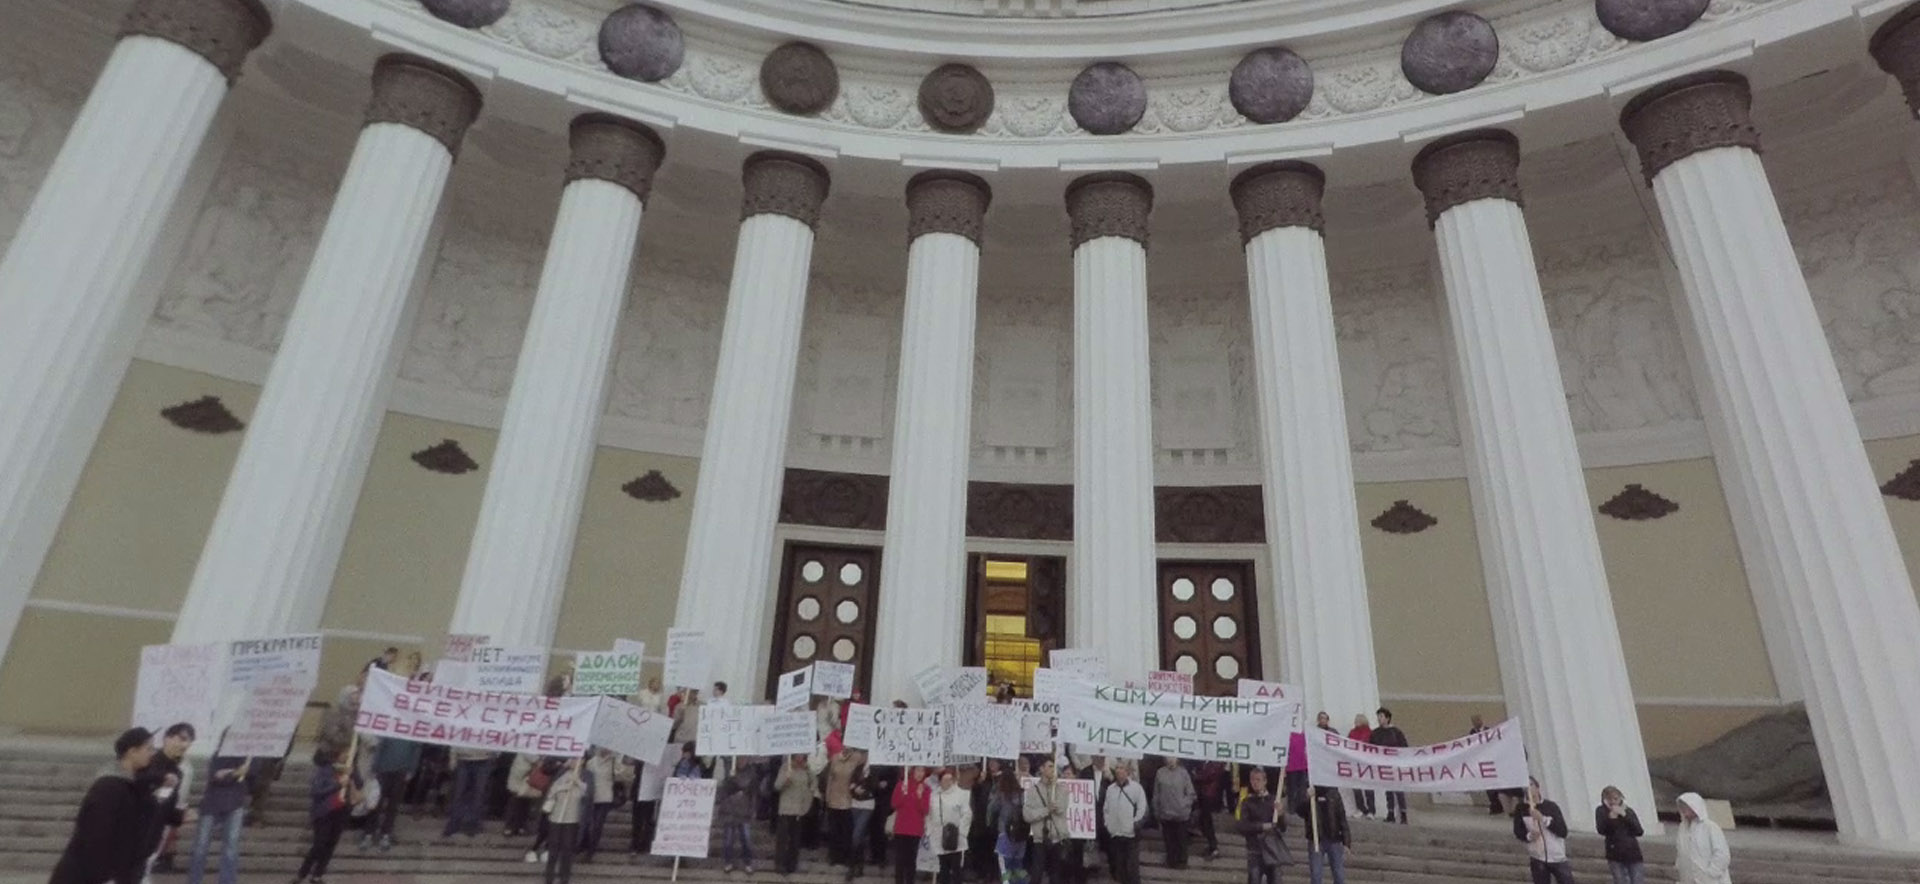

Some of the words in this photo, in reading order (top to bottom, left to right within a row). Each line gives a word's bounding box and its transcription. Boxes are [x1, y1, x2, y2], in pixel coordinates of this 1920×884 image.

[231, 636, 319, 656] ПРЕКРАТИТЕ
[471, 647, 504, 663] НЕТ
[579, 652, 639, 669] ДОЛОЙ
[393, 694, 468, 720] ВСЕХ
[481, 706, 574, 729] СТРАН
[1094, 684, 1163, 707] КОМУ
[1179, 695, 1269, 716] НУЖНО
[355, 710, 584, 753] ОБЪЕДИНЯЙТЕСЬ
[1143, 712, 1217, 735] ВАШЕ
[1337, 760, 1498, 783] БИЕННАЛЕ
